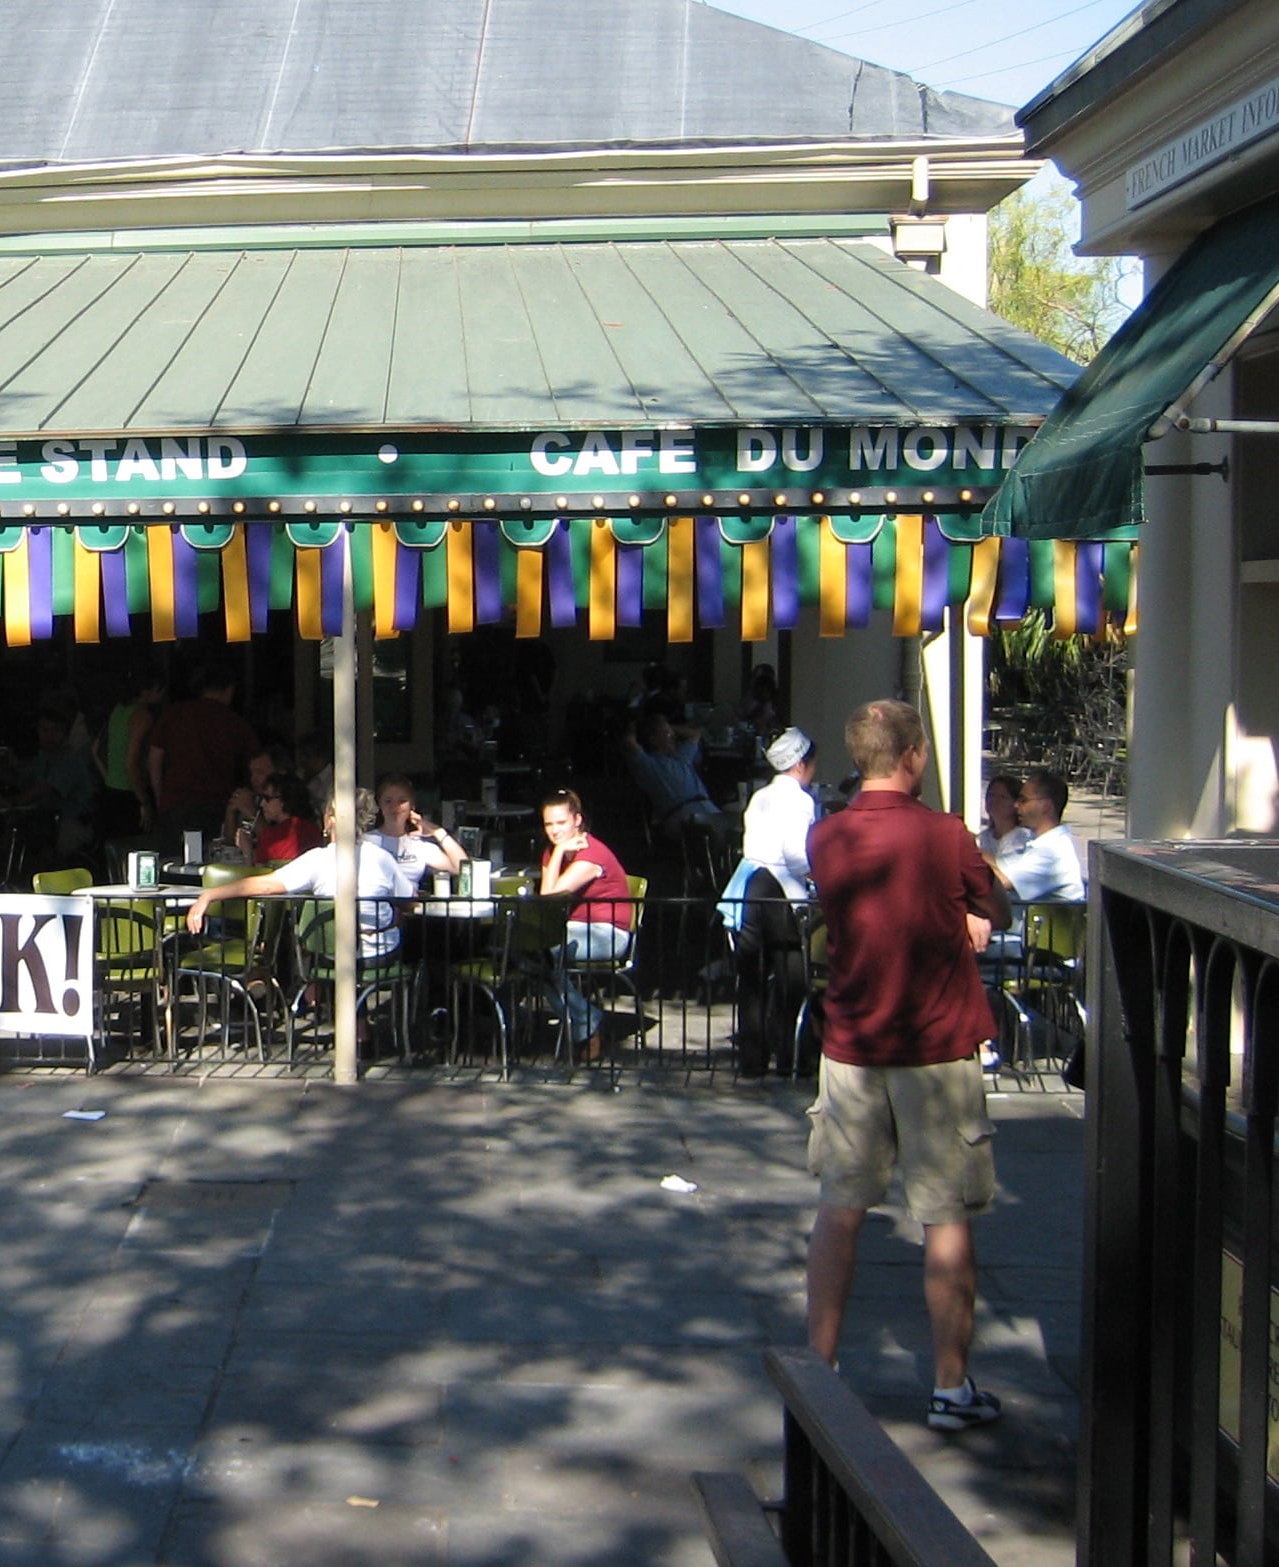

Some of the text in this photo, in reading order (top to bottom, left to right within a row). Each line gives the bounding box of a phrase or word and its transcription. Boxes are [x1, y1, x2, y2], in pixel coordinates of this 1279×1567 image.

[1132, 86, 1279, 198] FRENCH MARKET INFO
[40, 436, 248, 483] STAND
[529, 431, 697, 477] CAFE
[736, 427, 824, 472] DU
